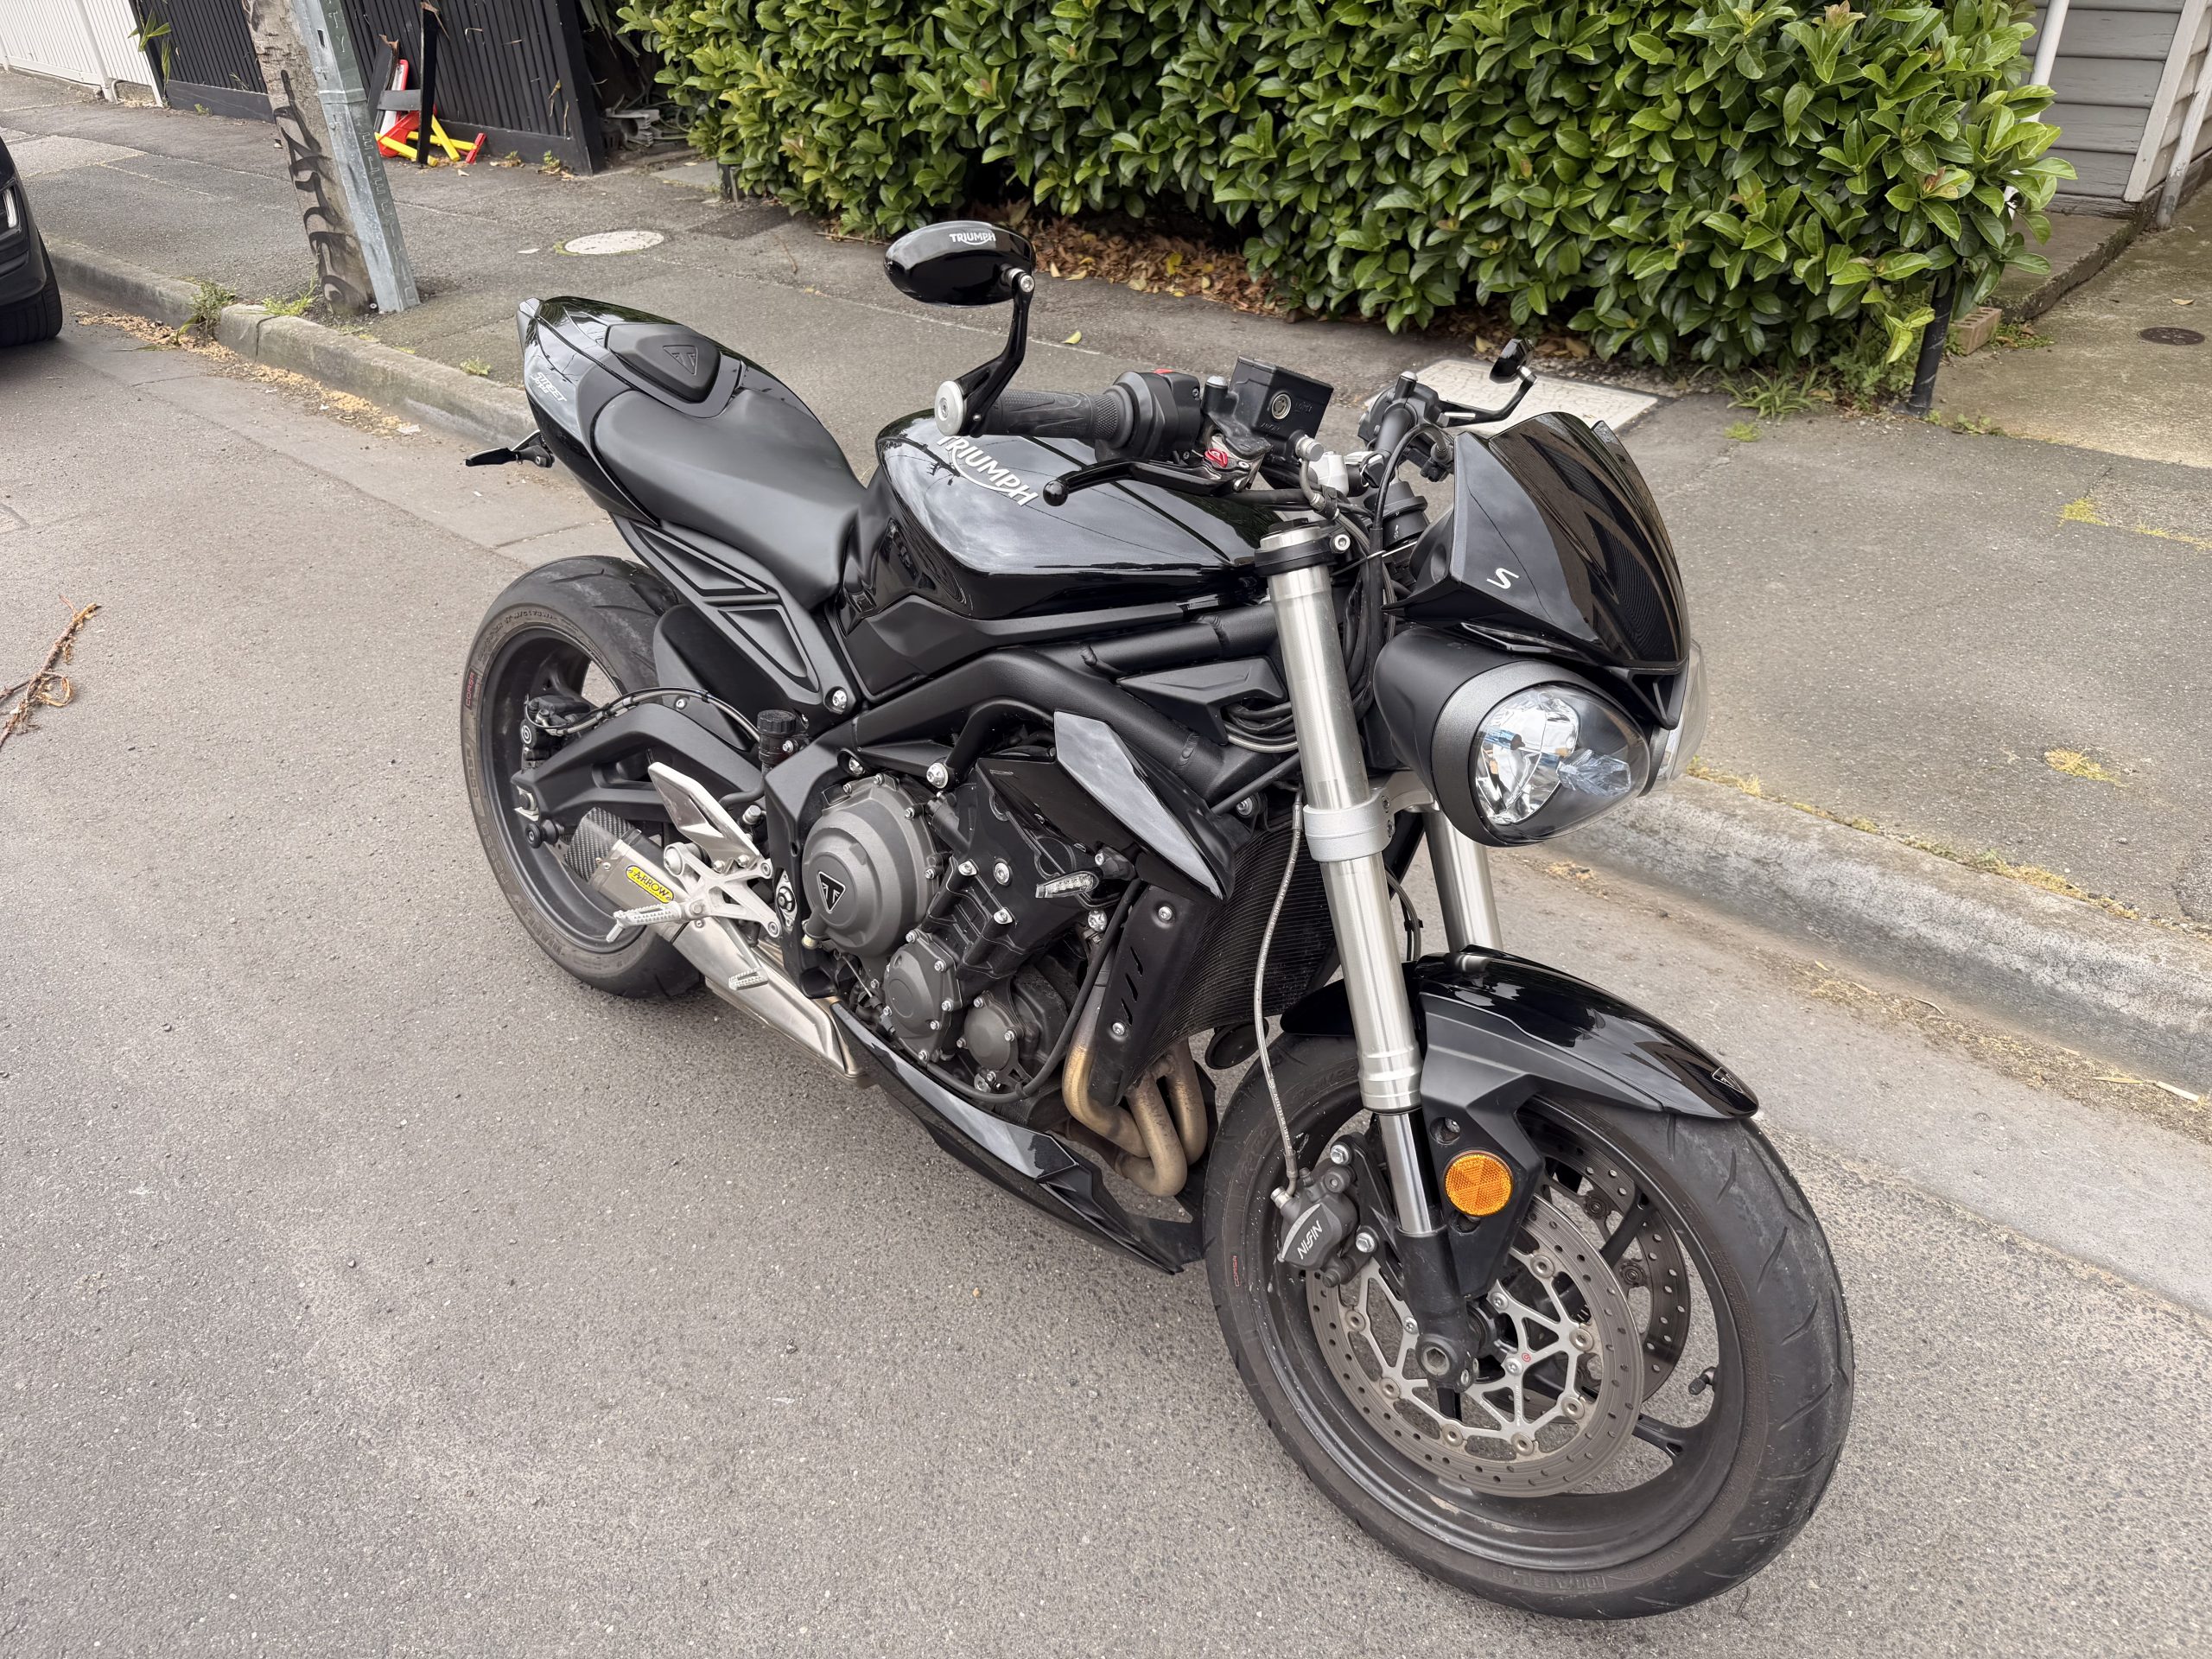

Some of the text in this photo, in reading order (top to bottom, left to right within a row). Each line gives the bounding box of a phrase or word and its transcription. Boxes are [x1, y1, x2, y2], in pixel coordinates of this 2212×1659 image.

[950, 232, 996, 245] TRIUMPH
[537, 372, 567, 401] STREET
[937, 436, 1039, 506] TRIUMPH
[466, 671, 475, 707] CORSA
[480, 823, 510, 885] ROSSO
[633, 871, 670, 896] ARROW
